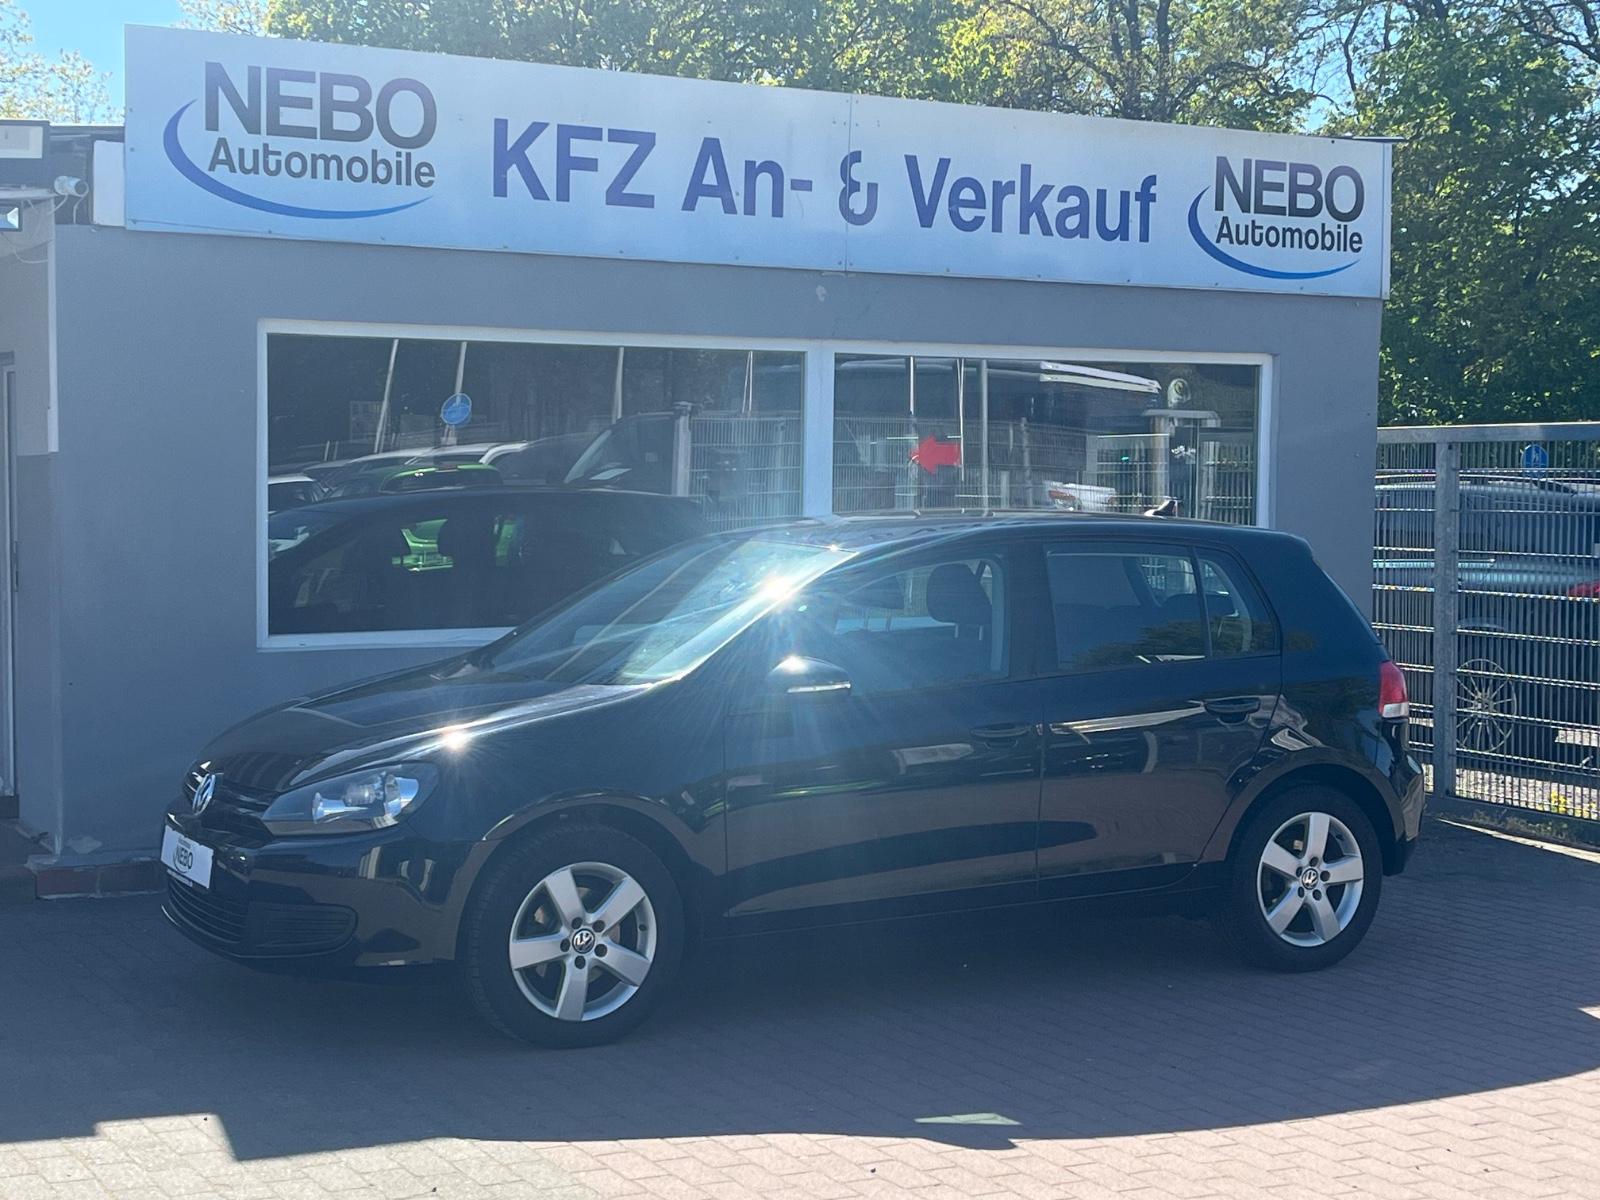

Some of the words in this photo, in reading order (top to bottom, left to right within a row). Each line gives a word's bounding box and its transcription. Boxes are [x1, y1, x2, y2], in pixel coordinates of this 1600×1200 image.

[205, 62, 437, 149] NEBO
[208, 137, 435, 188] Automobile
[493, 118, 656, 208] KFZ
[682, 137, 813, 218] An-
[839, 150, 878, 226] &
[905, 154, 1157, 242] Verkauf
[1215, 156, 1364, 222] NEBO
[1215, 216, 1363, 253] Automobile
